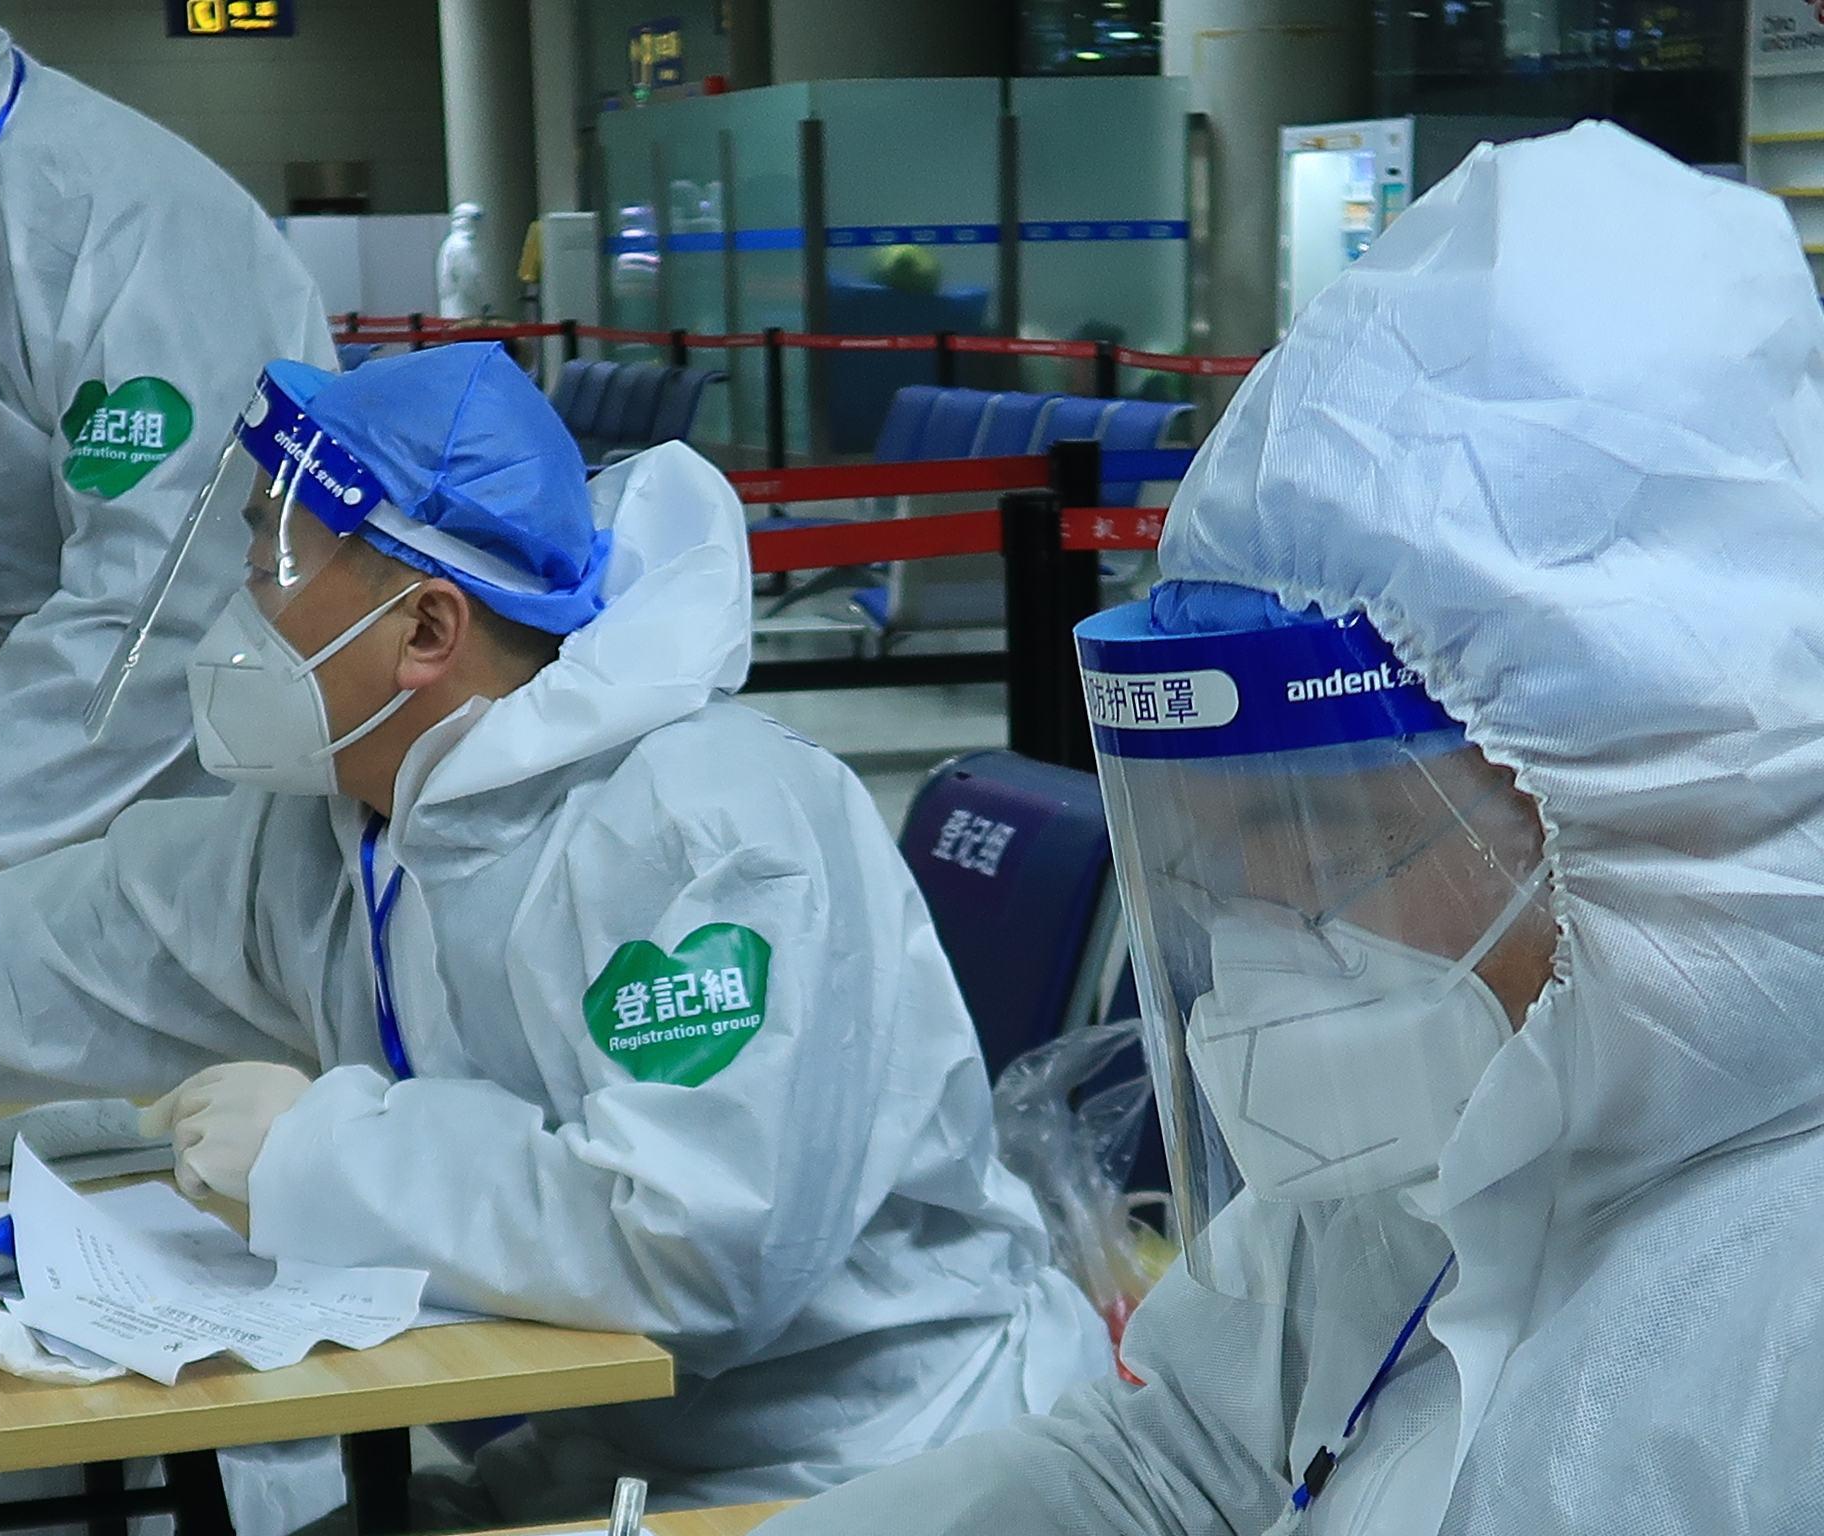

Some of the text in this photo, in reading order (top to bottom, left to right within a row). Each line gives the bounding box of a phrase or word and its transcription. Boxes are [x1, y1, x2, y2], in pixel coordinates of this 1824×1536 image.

[1287, 661, 1396, 702] andent
[612, 965, 752, 1031] 登記組
[609, 1012, 761, 1051] Registration group
